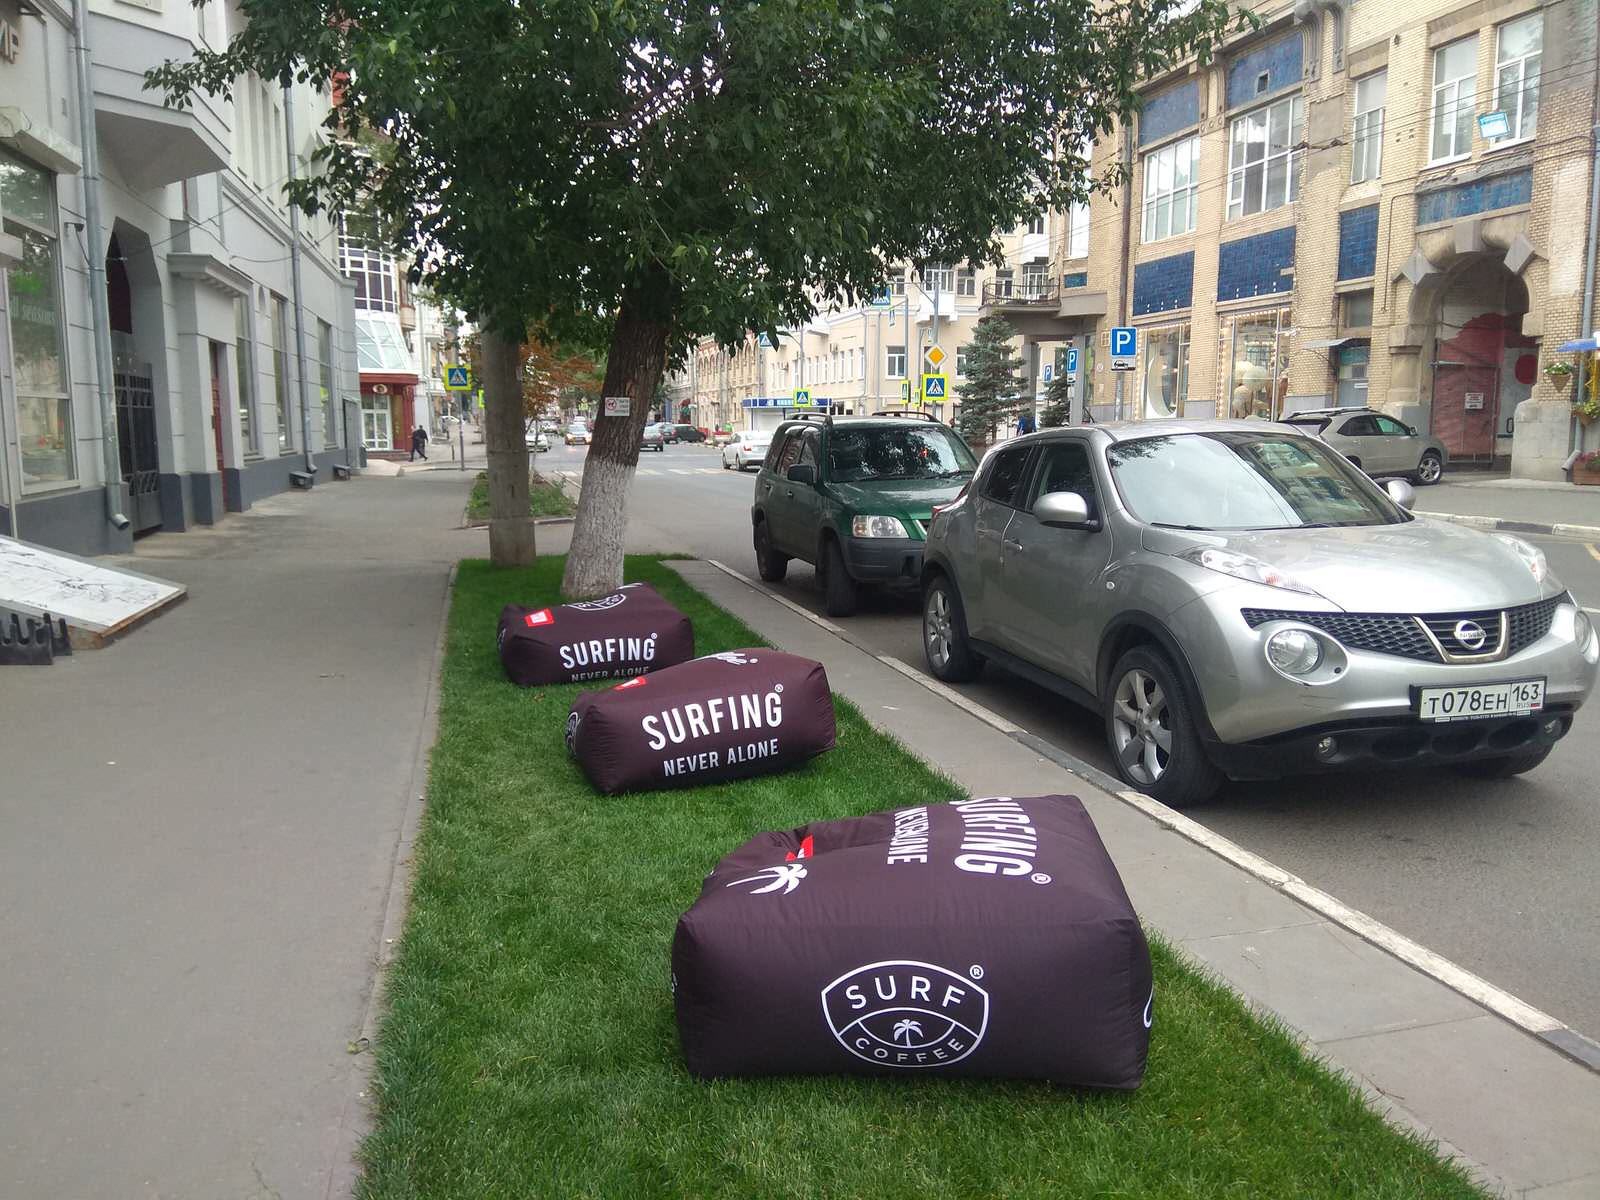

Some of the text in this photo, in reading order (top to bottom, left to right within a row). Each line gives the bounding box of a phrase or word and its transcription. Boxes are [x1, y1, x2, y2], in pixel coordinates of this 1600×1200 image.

[1116, 331, 1131, 353] P
[560, 637, 655, 669] SURFING
[571, 670, 608, 682] NEVER
[1512, 684, 1539, 702] 163
[642, 692, 782, 750] SURFING
[664, 738, 779, 776] NEVER ALONE
[845, 975, 966, 1010] SURF
[855, 1037, 964, 1063] COFFEE
